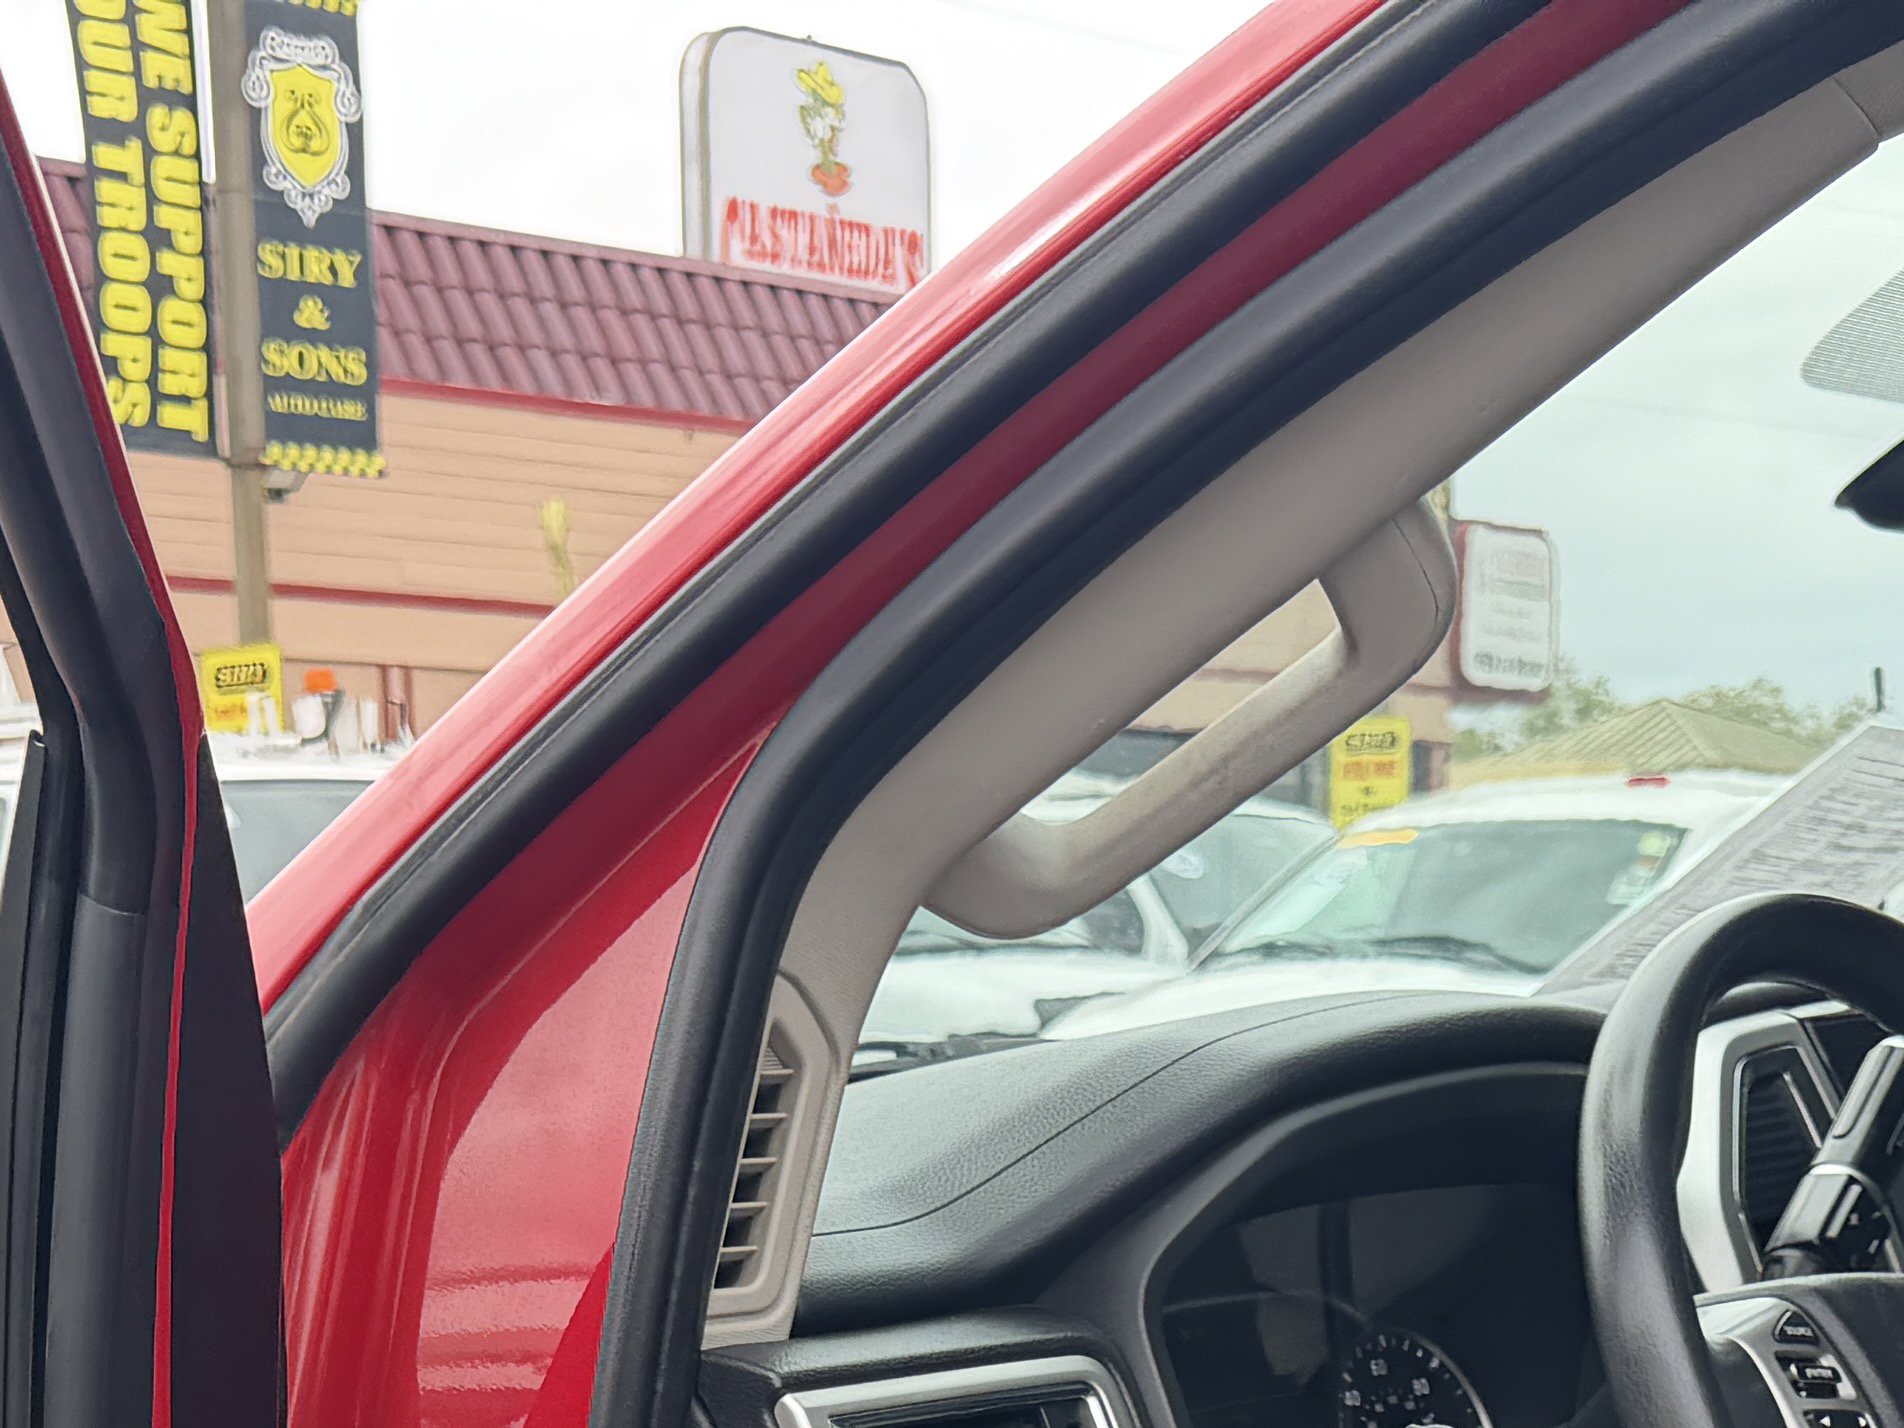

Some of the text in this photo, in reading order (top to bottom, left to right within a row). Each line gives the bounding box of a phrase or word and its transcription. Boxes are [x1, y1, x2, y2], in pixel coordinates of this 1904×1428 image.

[91, 136, 152, 428] TROOPS
[146, 103, 209, 443] SUPPORT
[257, 240, 363, 288] SIRY
[293, 295, 331, 331] &
[261, 337, 368, 386] SONS
